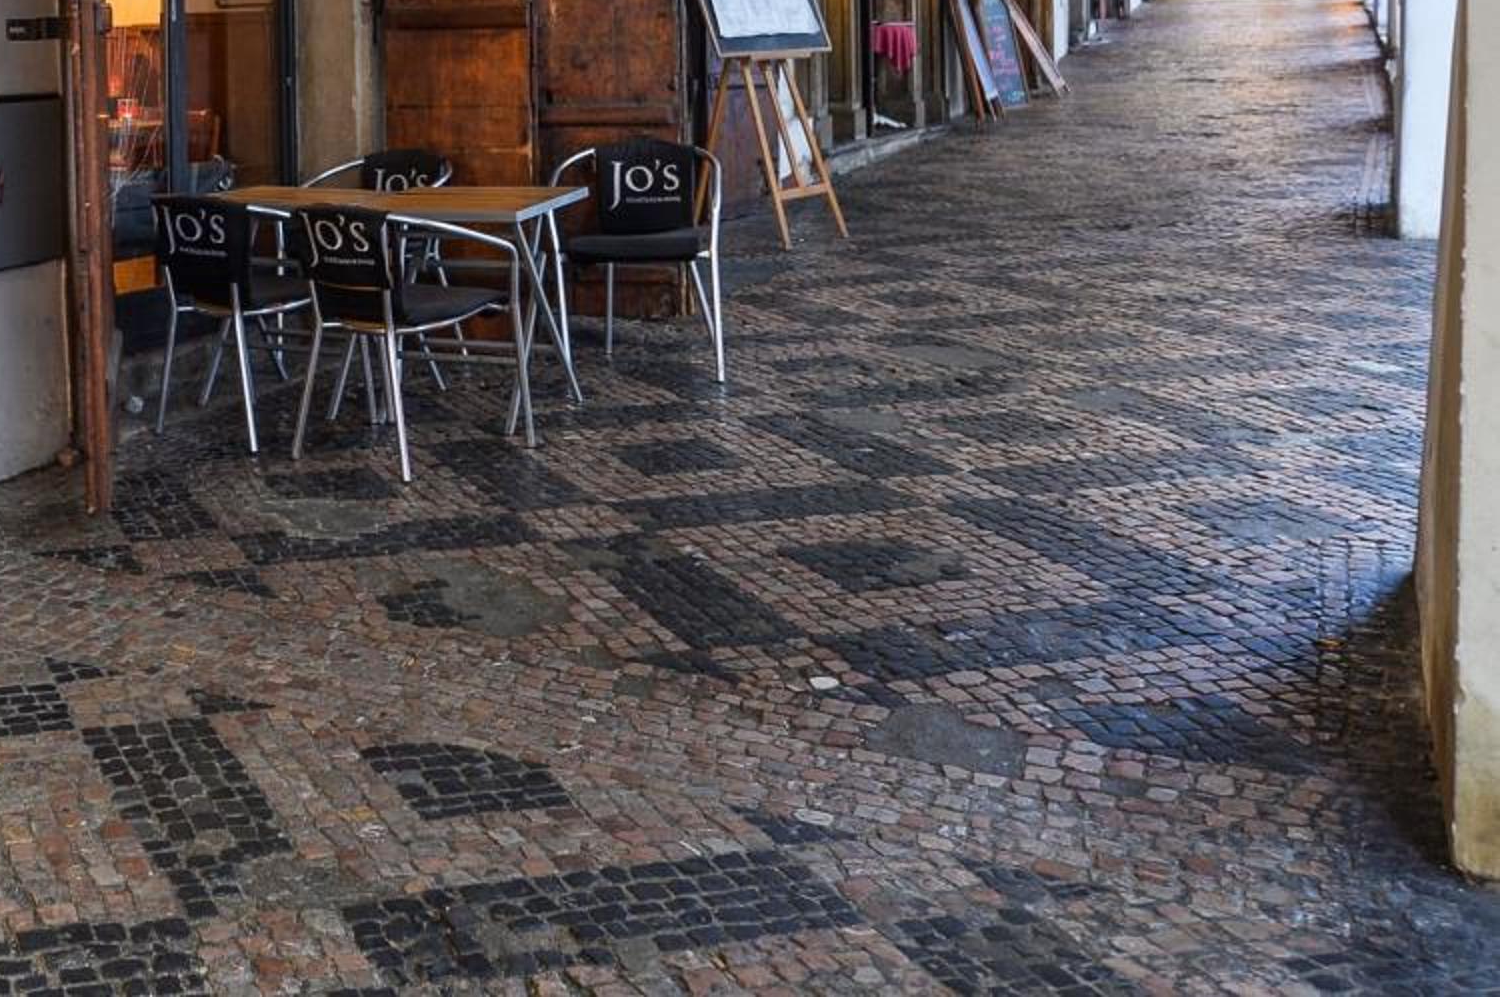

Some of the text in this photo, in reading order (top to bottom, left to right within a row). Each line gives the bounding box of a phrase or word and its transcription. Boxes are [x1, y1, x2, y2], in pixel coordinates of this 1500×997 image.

[611, 159, 681, 209] JO'S
[163, 205, 226, 255] JO'S
[298, 211, 370, 267] JO'S
